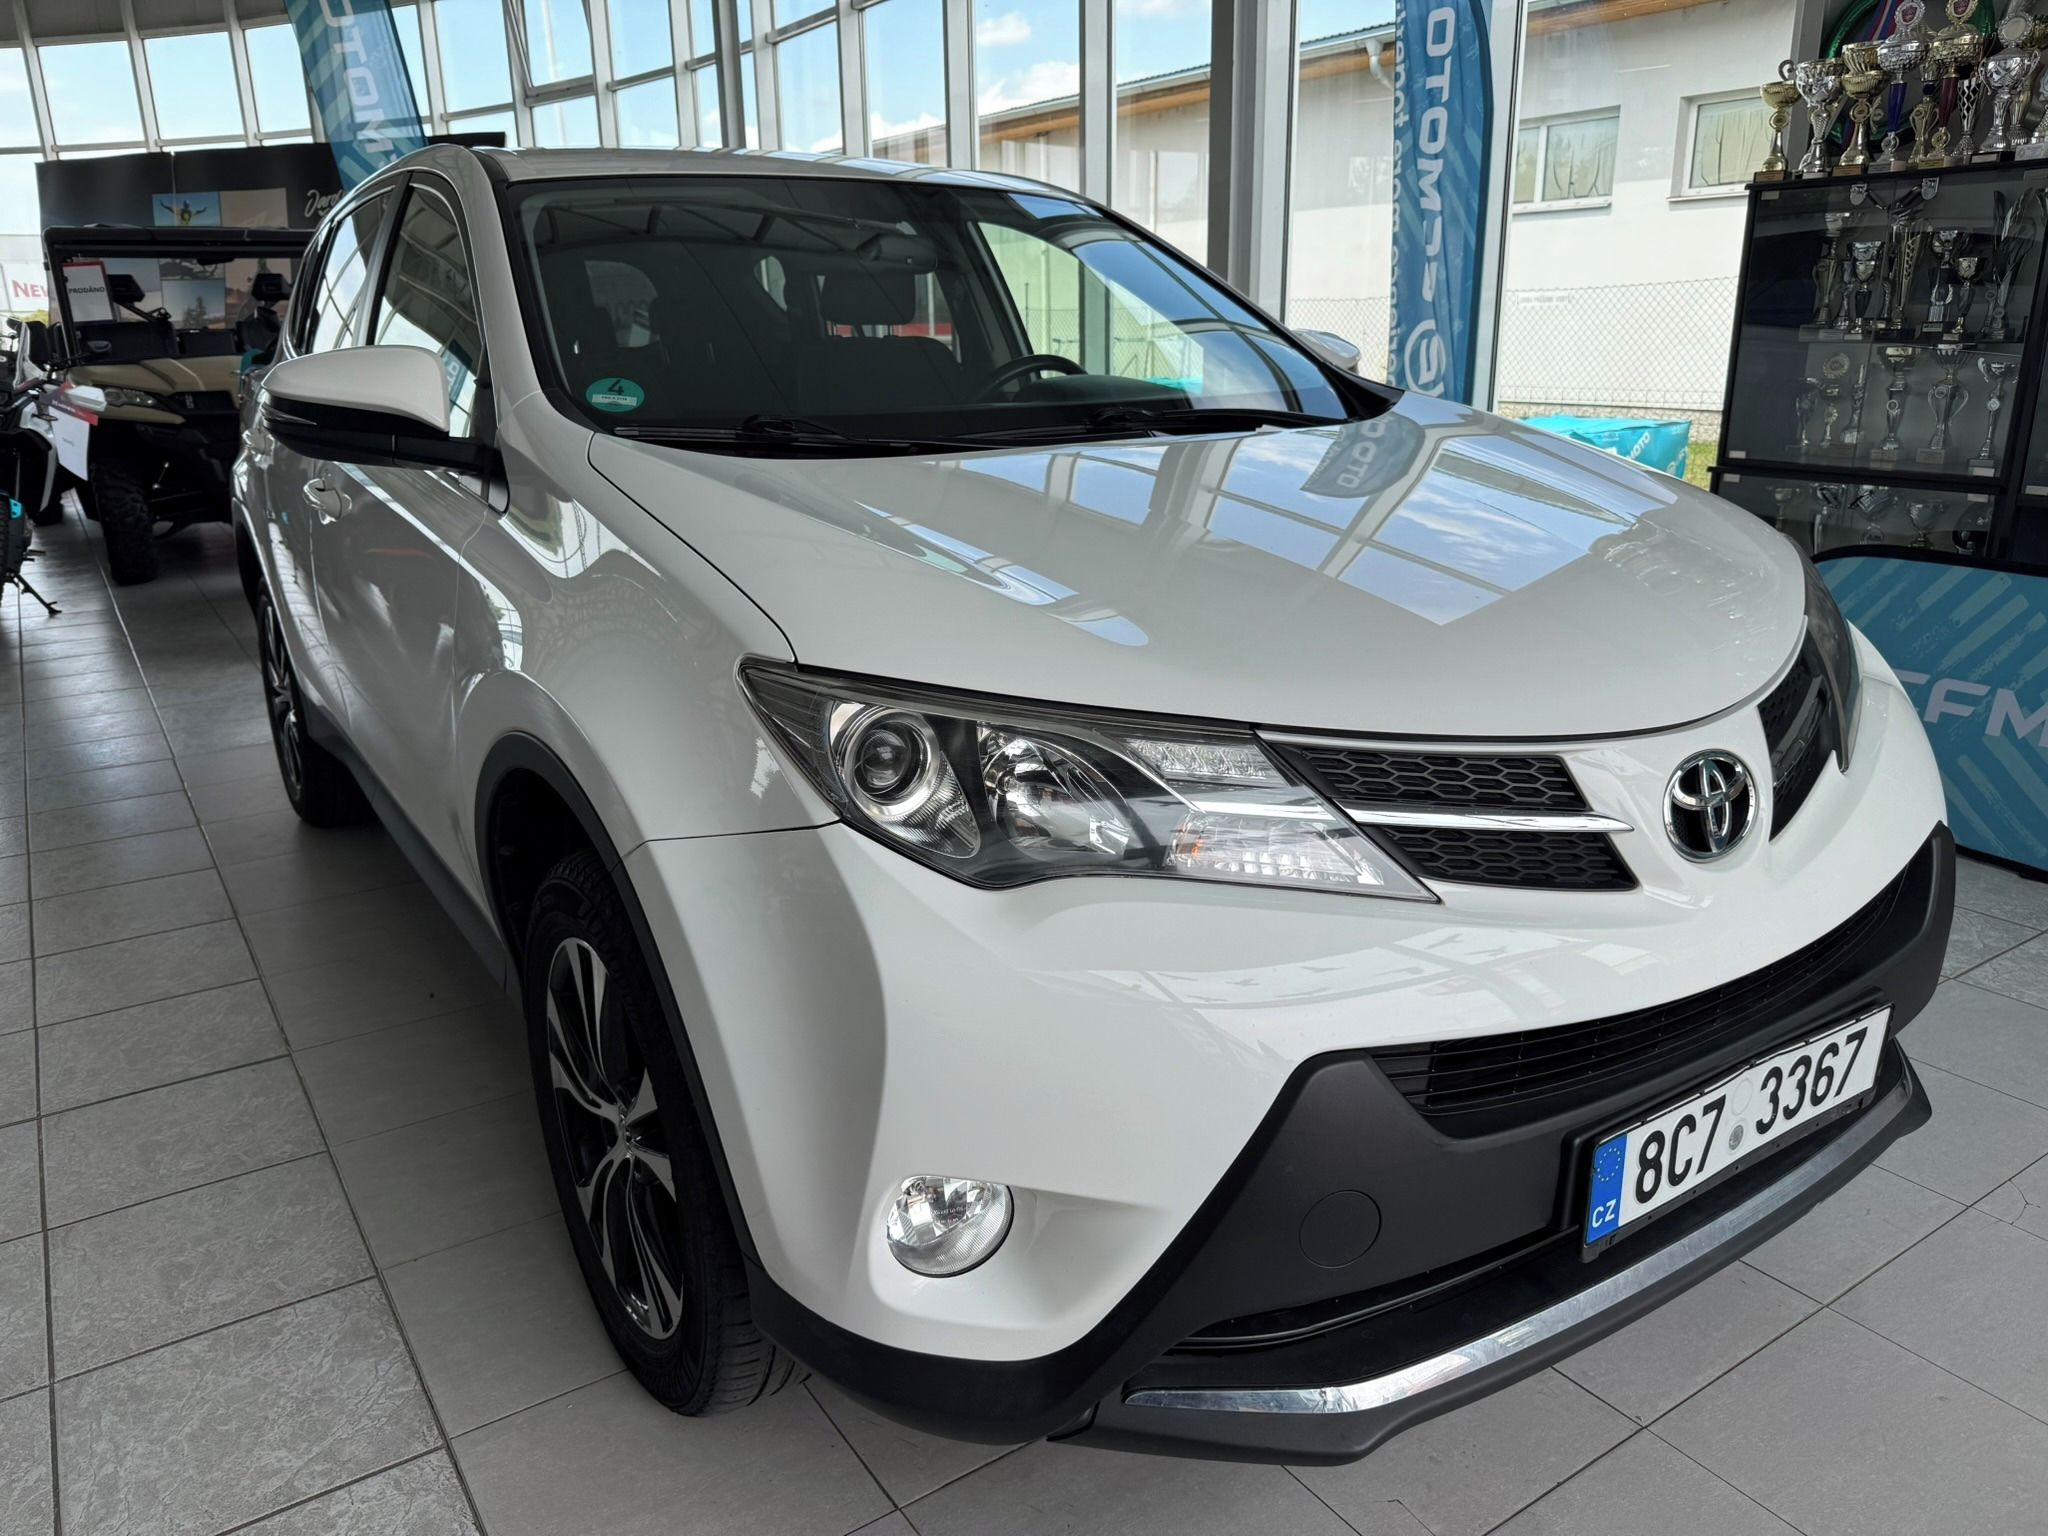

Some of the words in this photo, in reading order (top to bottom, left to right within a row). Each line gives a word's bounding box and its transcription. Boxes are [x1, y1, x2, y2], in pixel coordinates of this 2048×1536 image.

[607, 379, 625, 396] 4
[1635, 1094, 1727, 1204] 8C7
[1755, 1026, 1868, 1135] 3367
[1592, 1199, 1617, 1228] CZ
